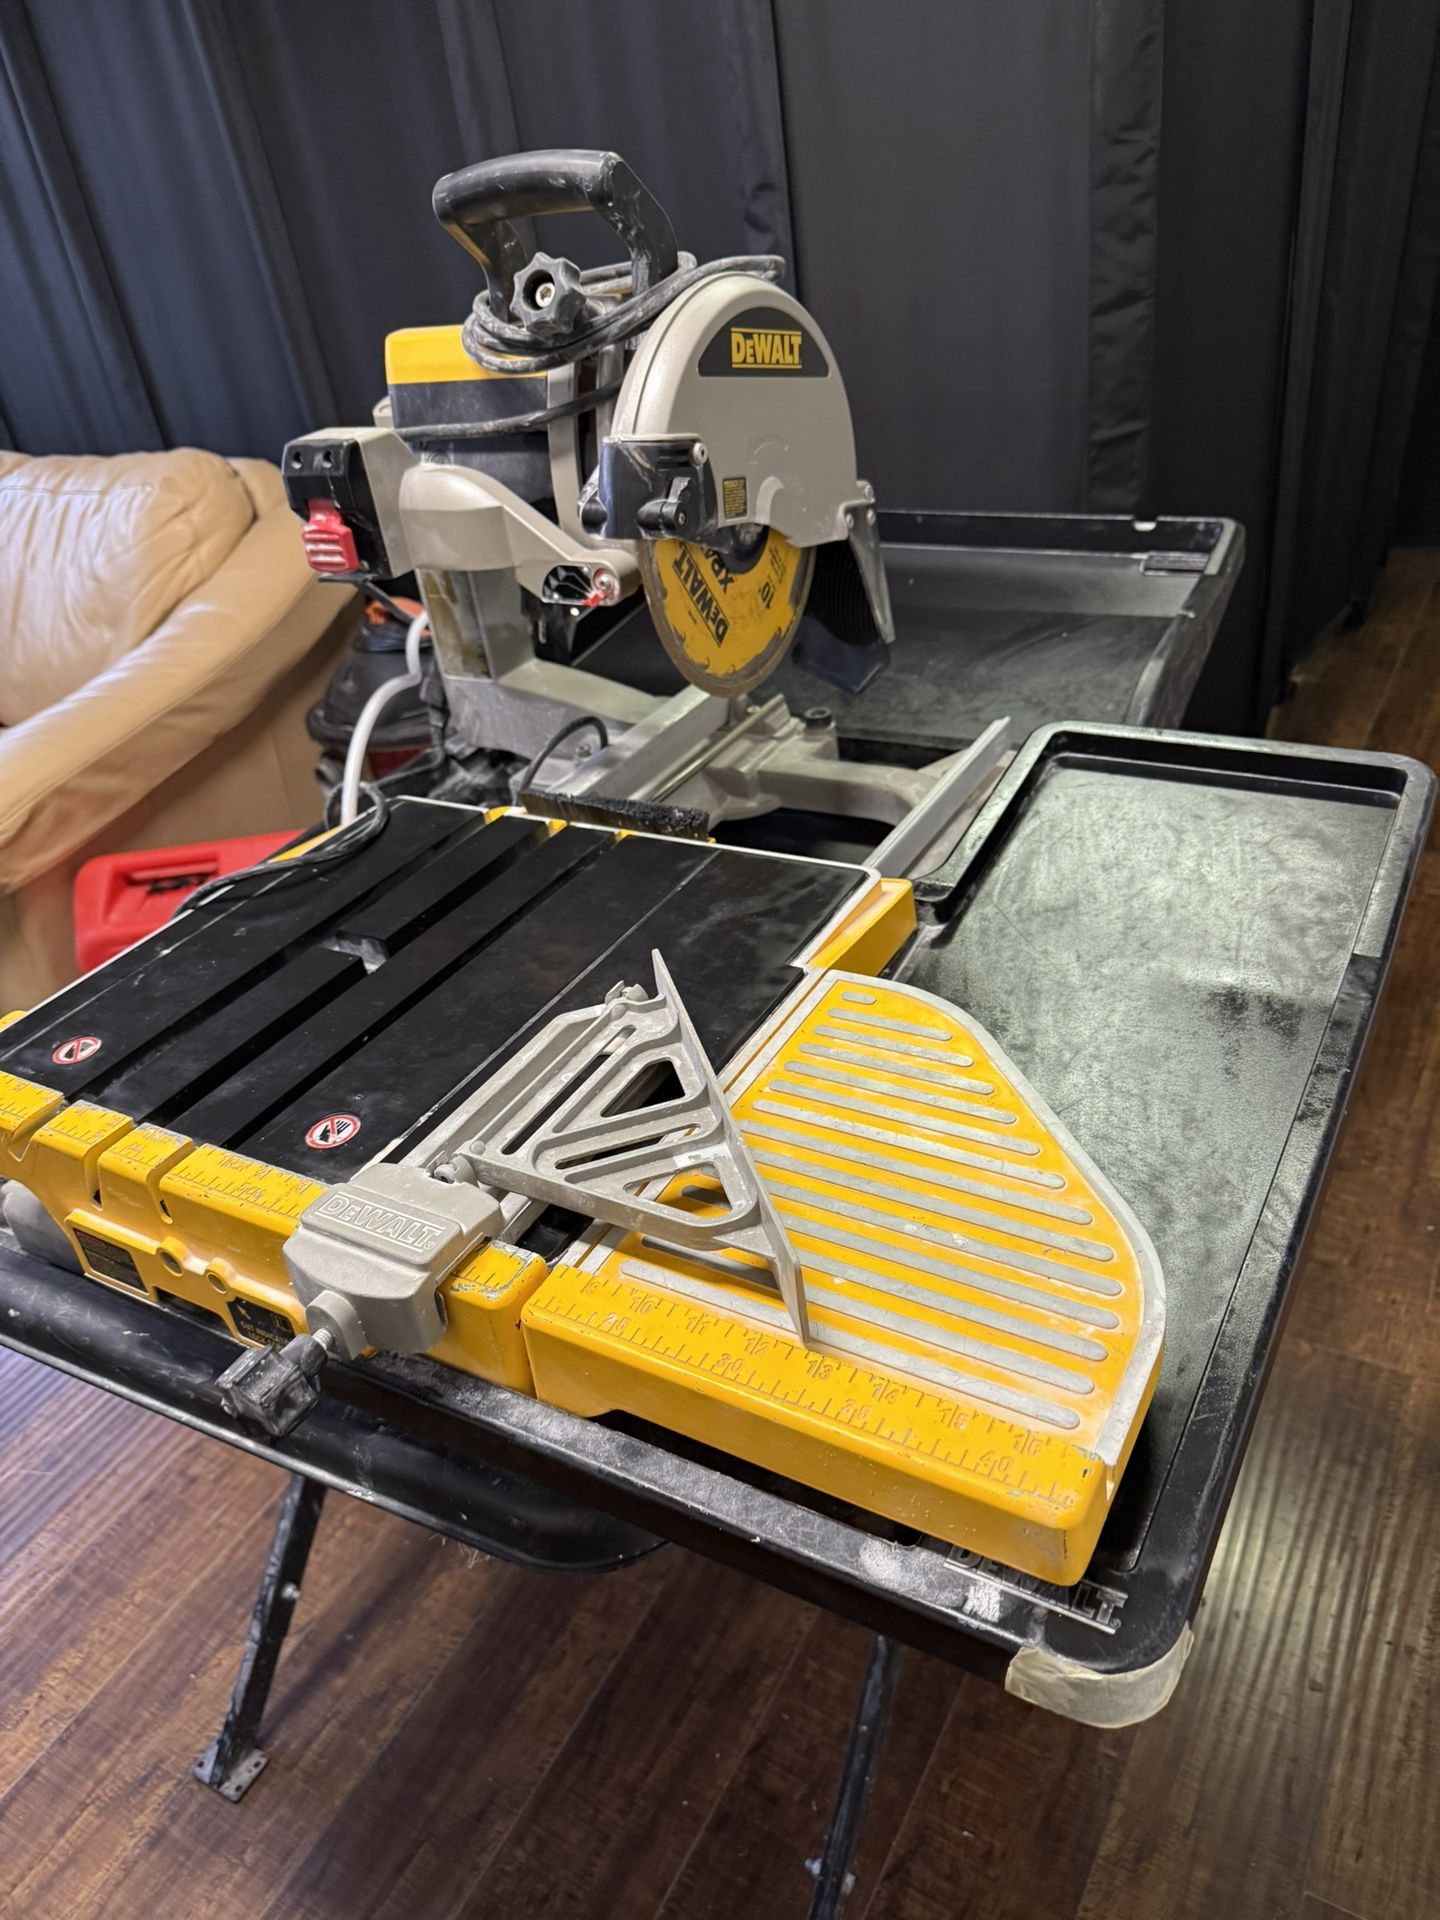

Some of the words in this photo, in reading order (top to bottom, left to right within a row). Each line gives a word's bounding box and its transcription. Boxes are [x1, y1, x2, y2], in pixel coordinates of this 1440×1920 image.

[731, 328, 802, 369] DEWALT
[743, 1335, 771, 1358] 12
[716, 1352, 744, 1372] 30
[806, 1359, 834, 1381] 13
[871, 1382, 901, 1405] 14
[979, 1450, 1014, 1473] 40
